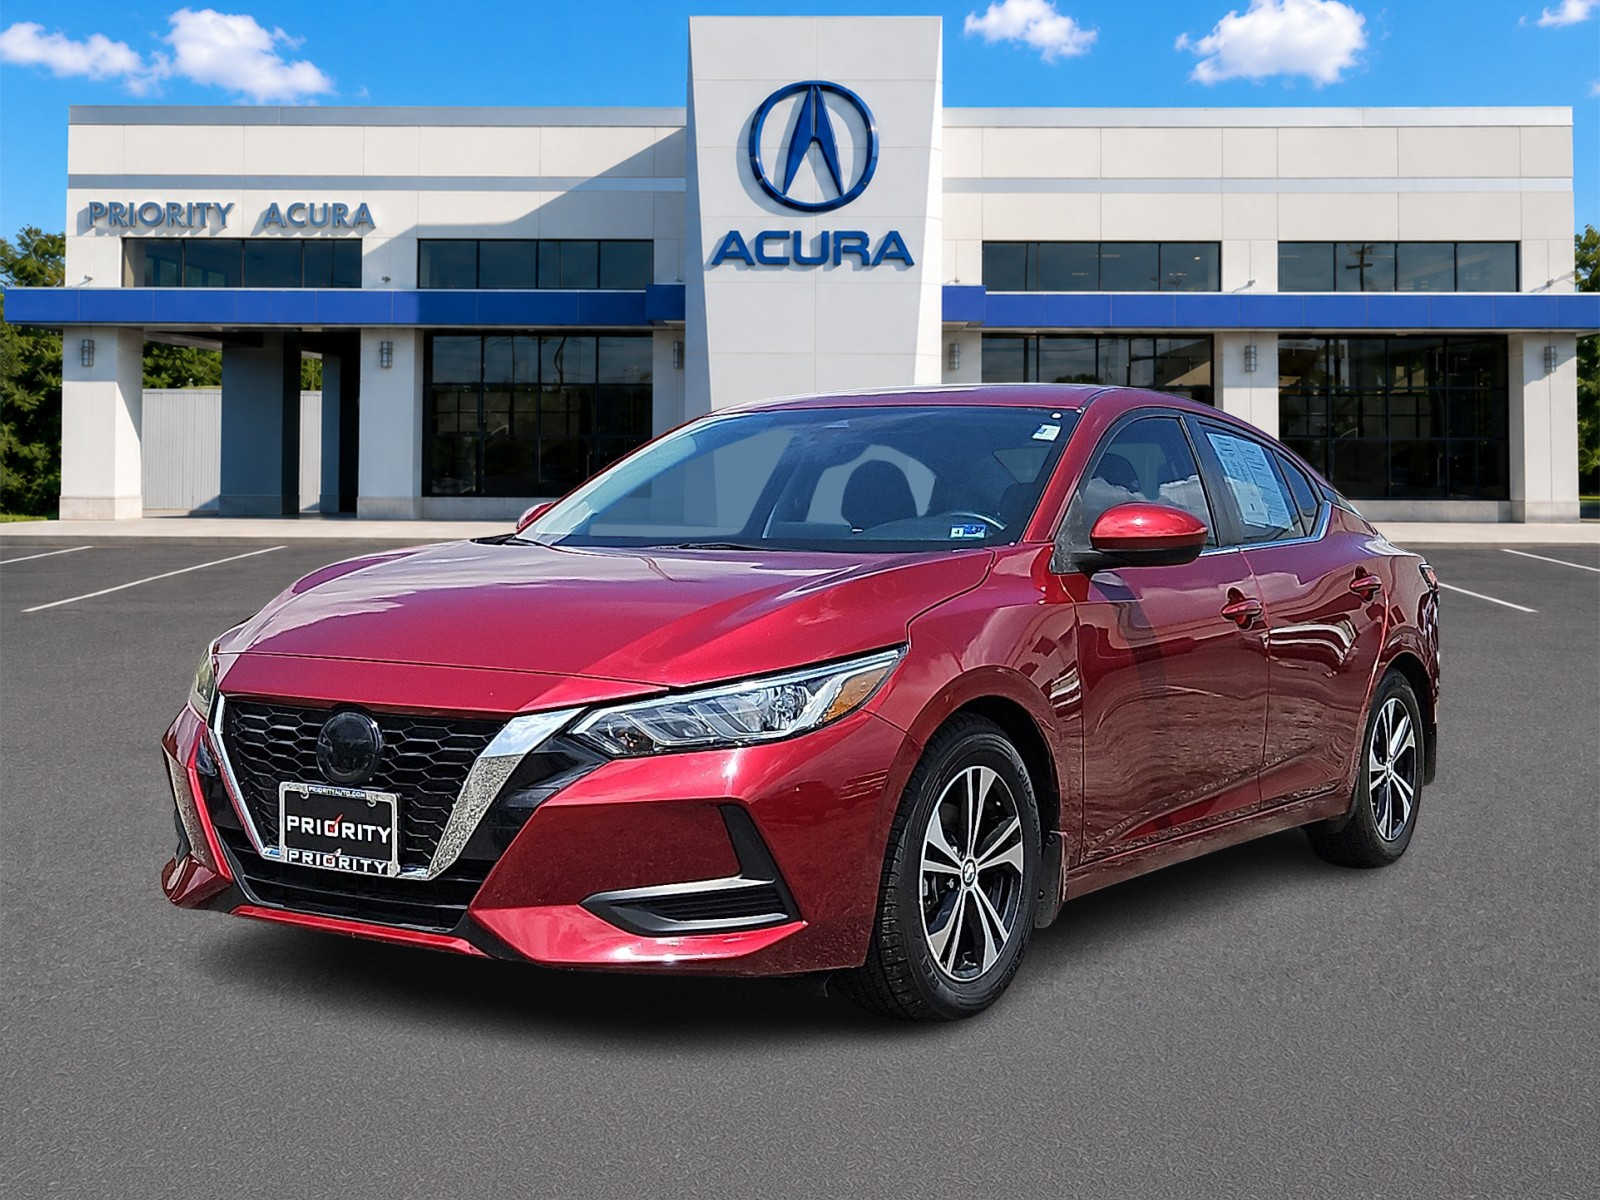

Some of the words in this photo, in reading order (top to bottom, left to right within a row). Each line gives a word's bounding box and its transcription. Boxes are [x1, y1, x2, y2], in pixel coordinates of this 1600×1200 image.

[88, 201, 235, 229] PRIORITY
[262, 201, 376, 229] ACURA
[711, 229, 915, 267] ACURA
[286, 814, 392, 844] PRIORITY
[288, 850, 387, 874] PRIORITY
